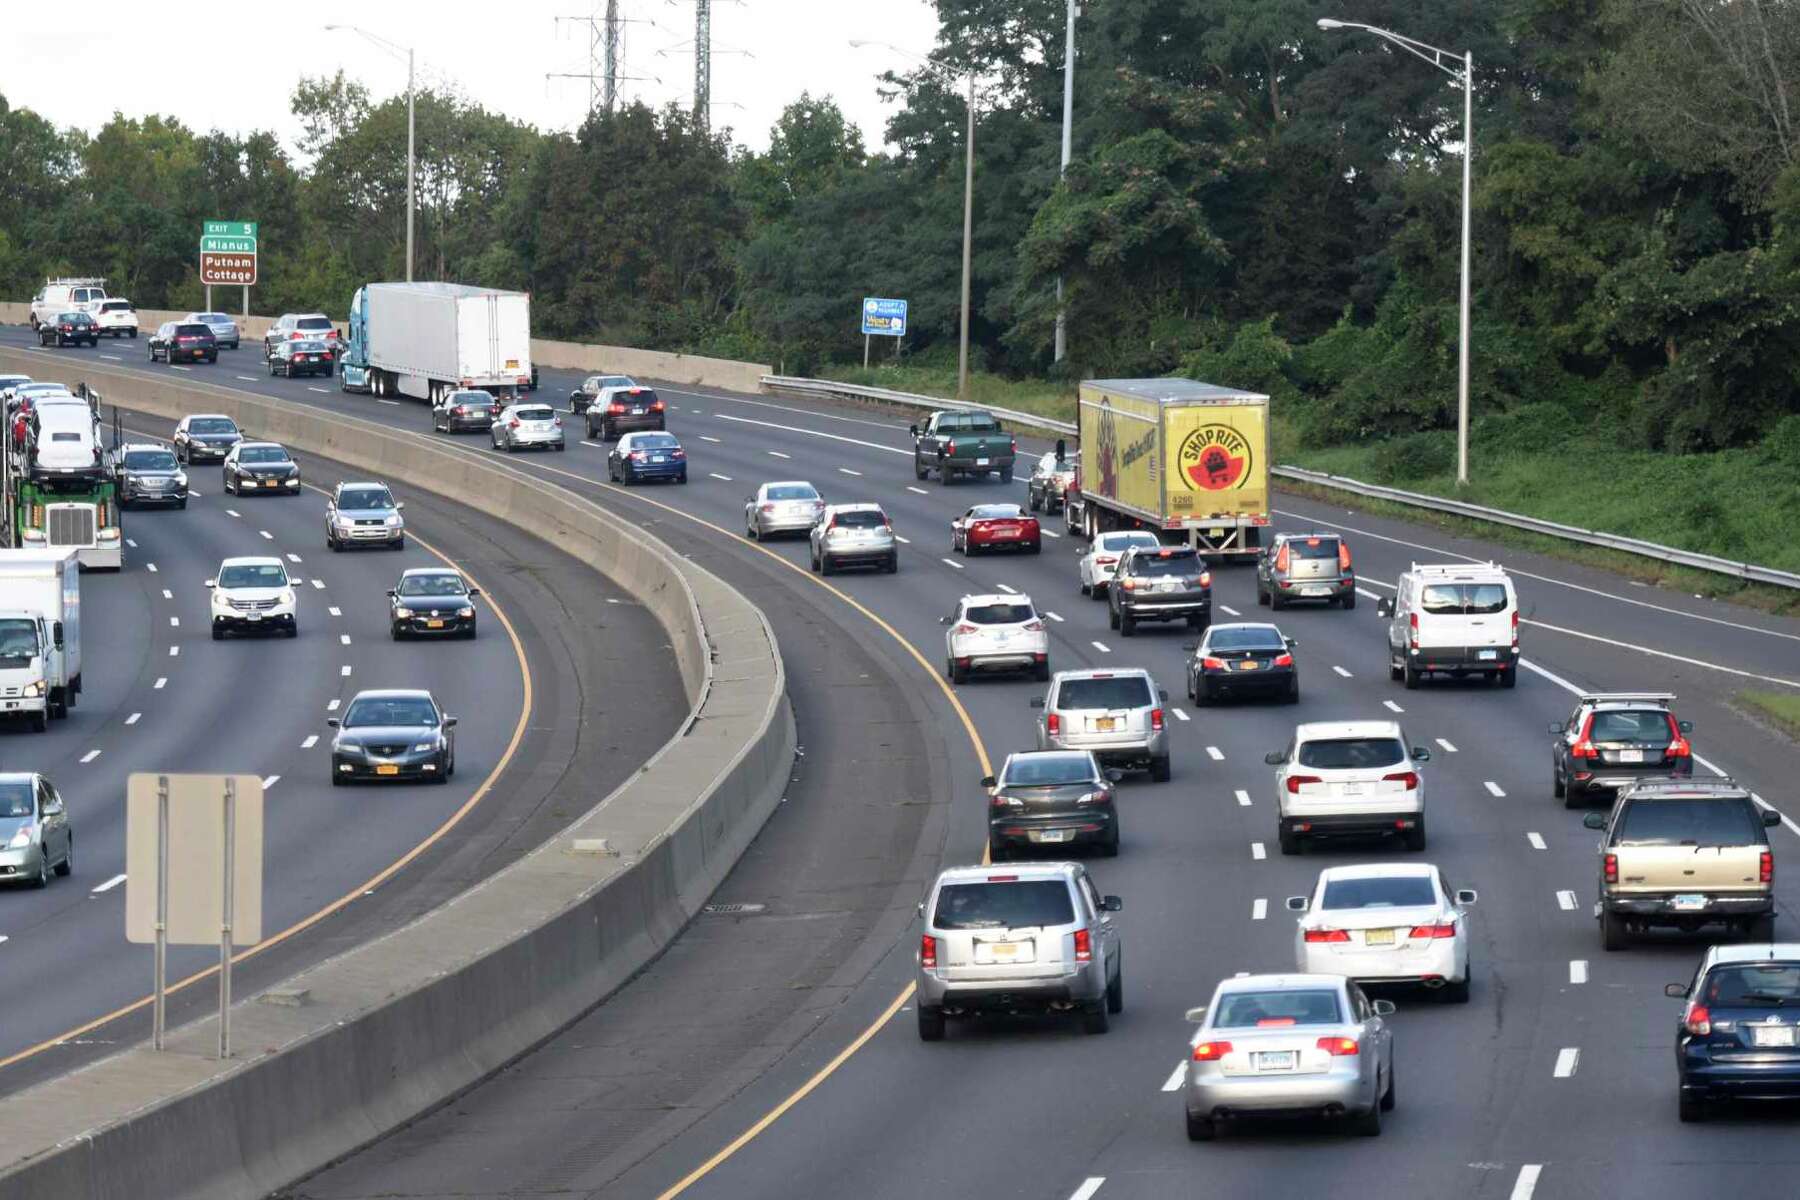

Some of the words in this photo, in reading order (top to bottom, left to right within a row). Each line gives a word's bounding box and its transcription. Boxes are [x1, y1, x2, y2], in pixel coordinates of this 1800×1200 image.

[209, 224, 228, 233] EXIT
[243, 223, 252, 235] 5
[207, 240, 250, 251] Mianus
[206, 256, 251, 267] Putnam
[206, 270, 251, 282] Cottage
